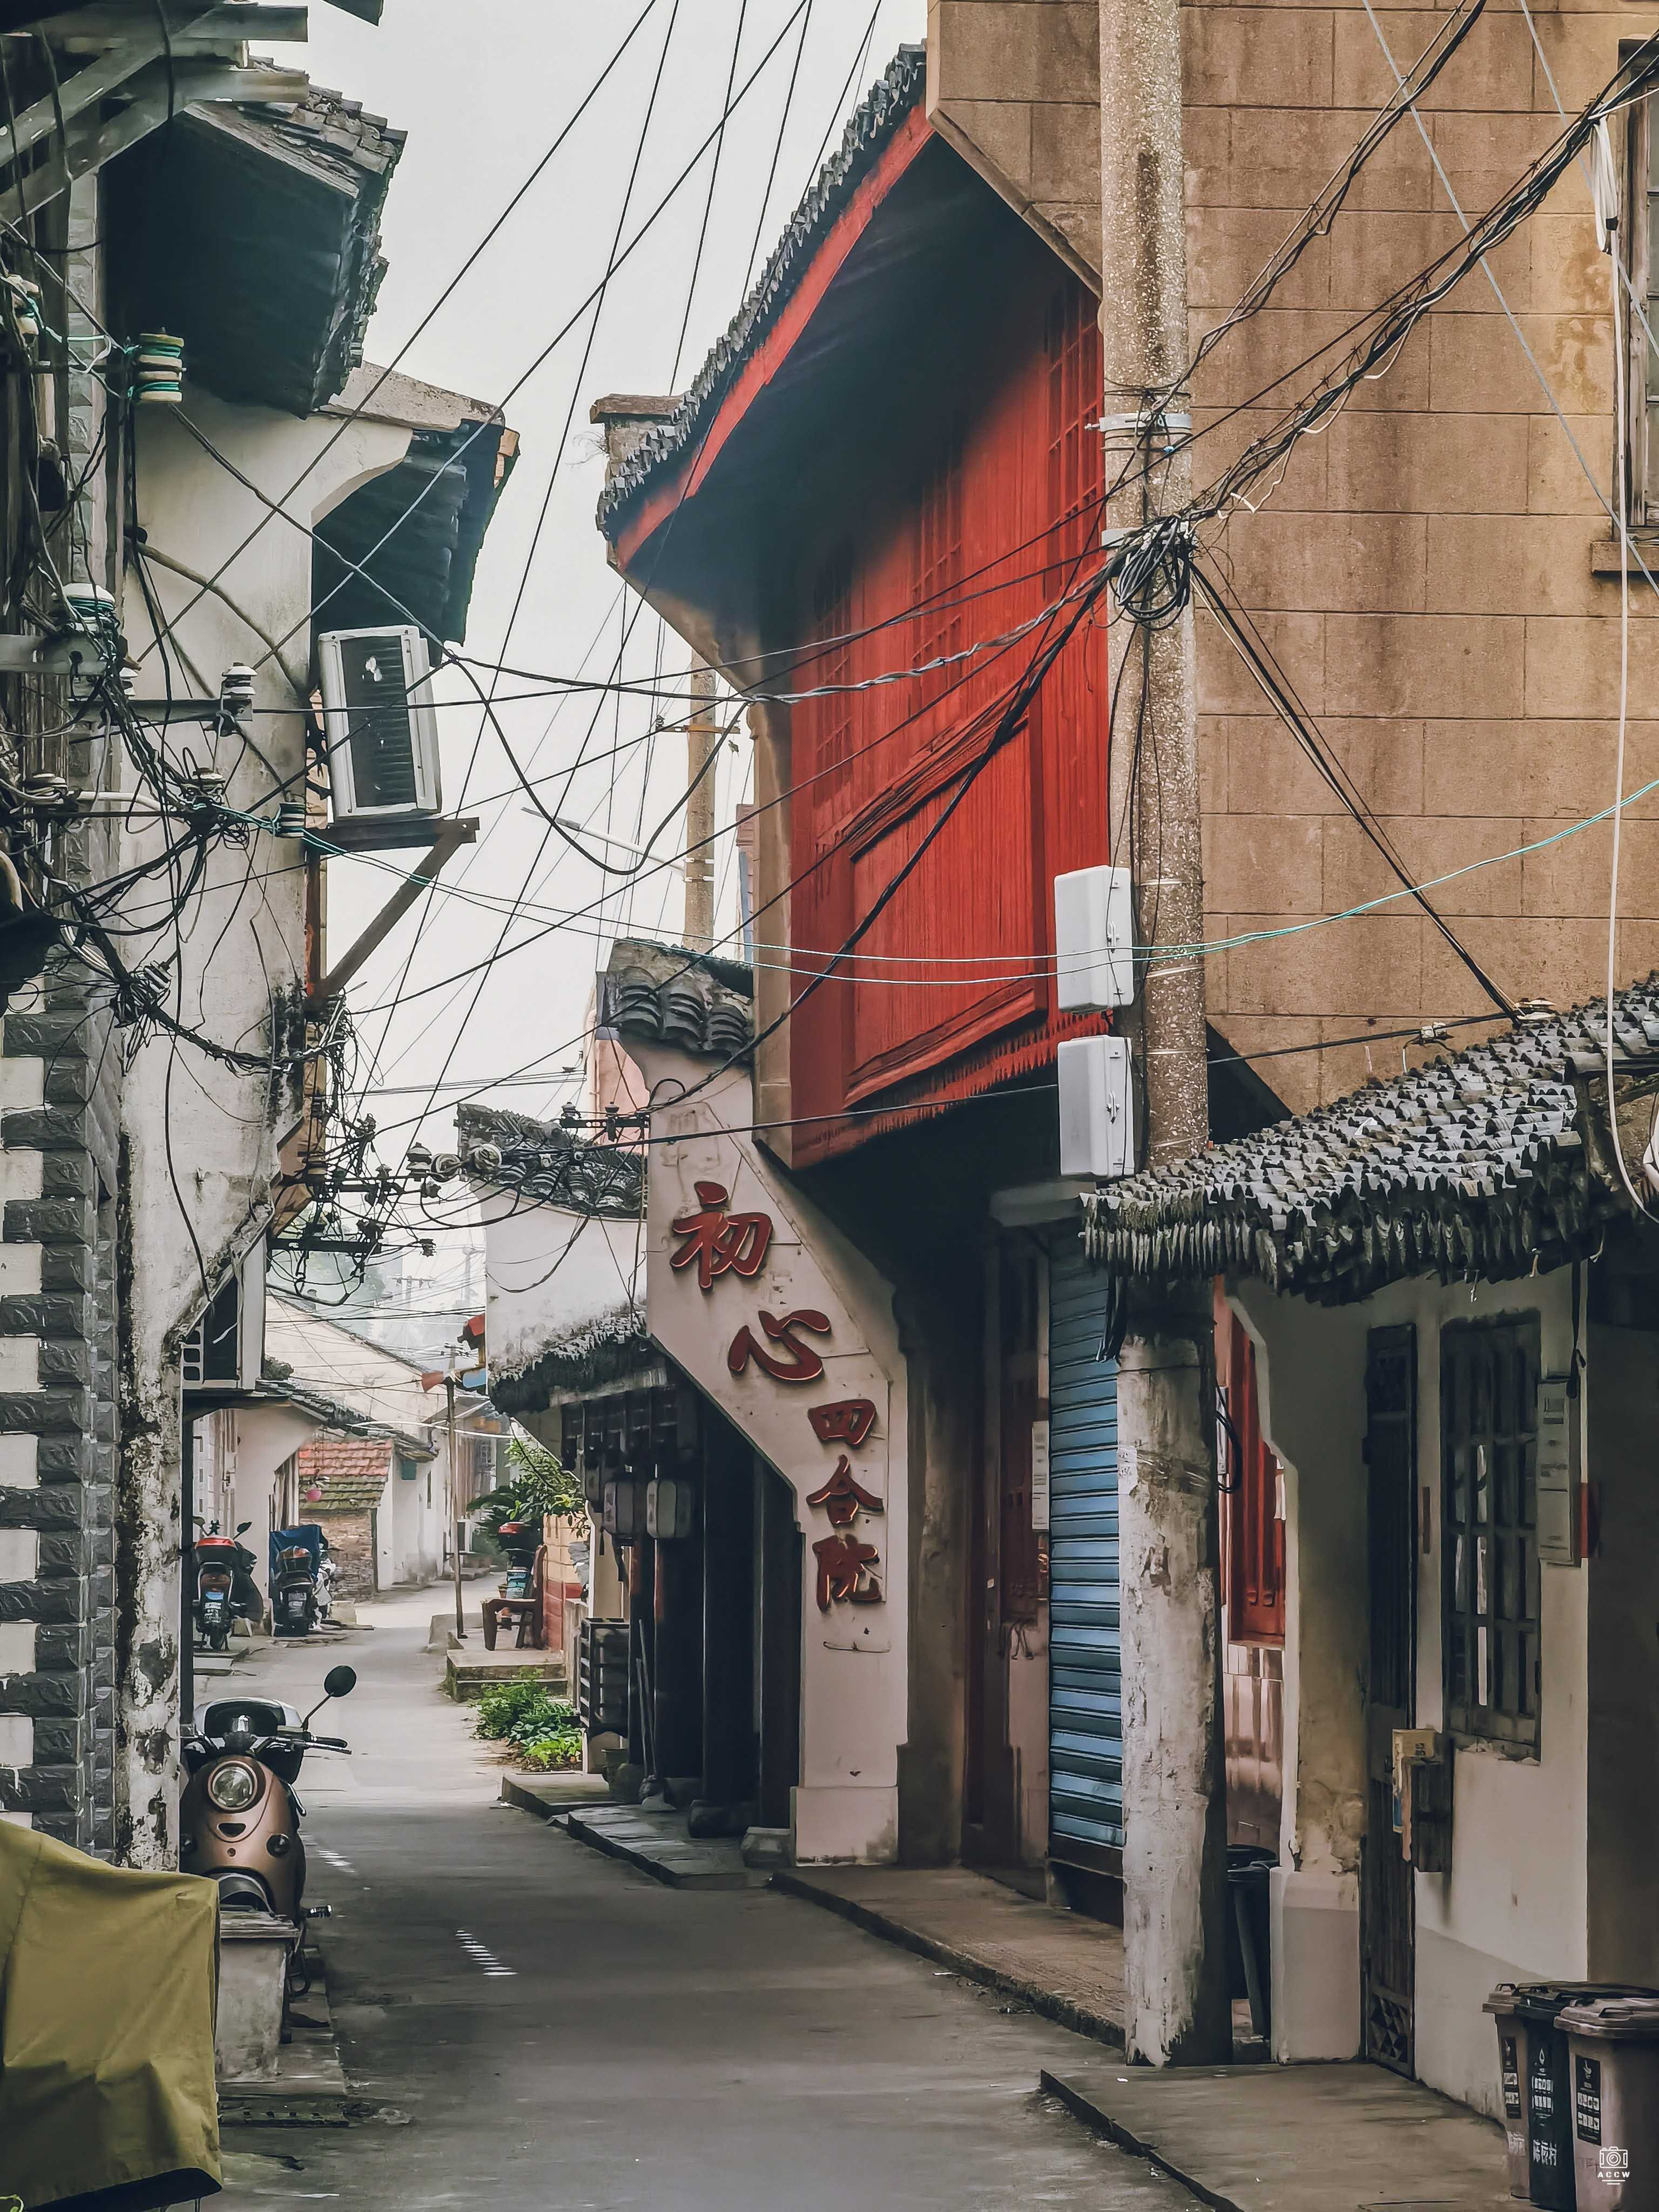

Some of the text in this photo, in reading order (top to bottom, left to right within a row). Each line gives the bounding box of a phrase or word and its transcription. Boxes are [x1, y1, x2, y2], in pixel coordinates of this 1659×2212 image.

[670, 1181, 884, 1611] 初心四合院
